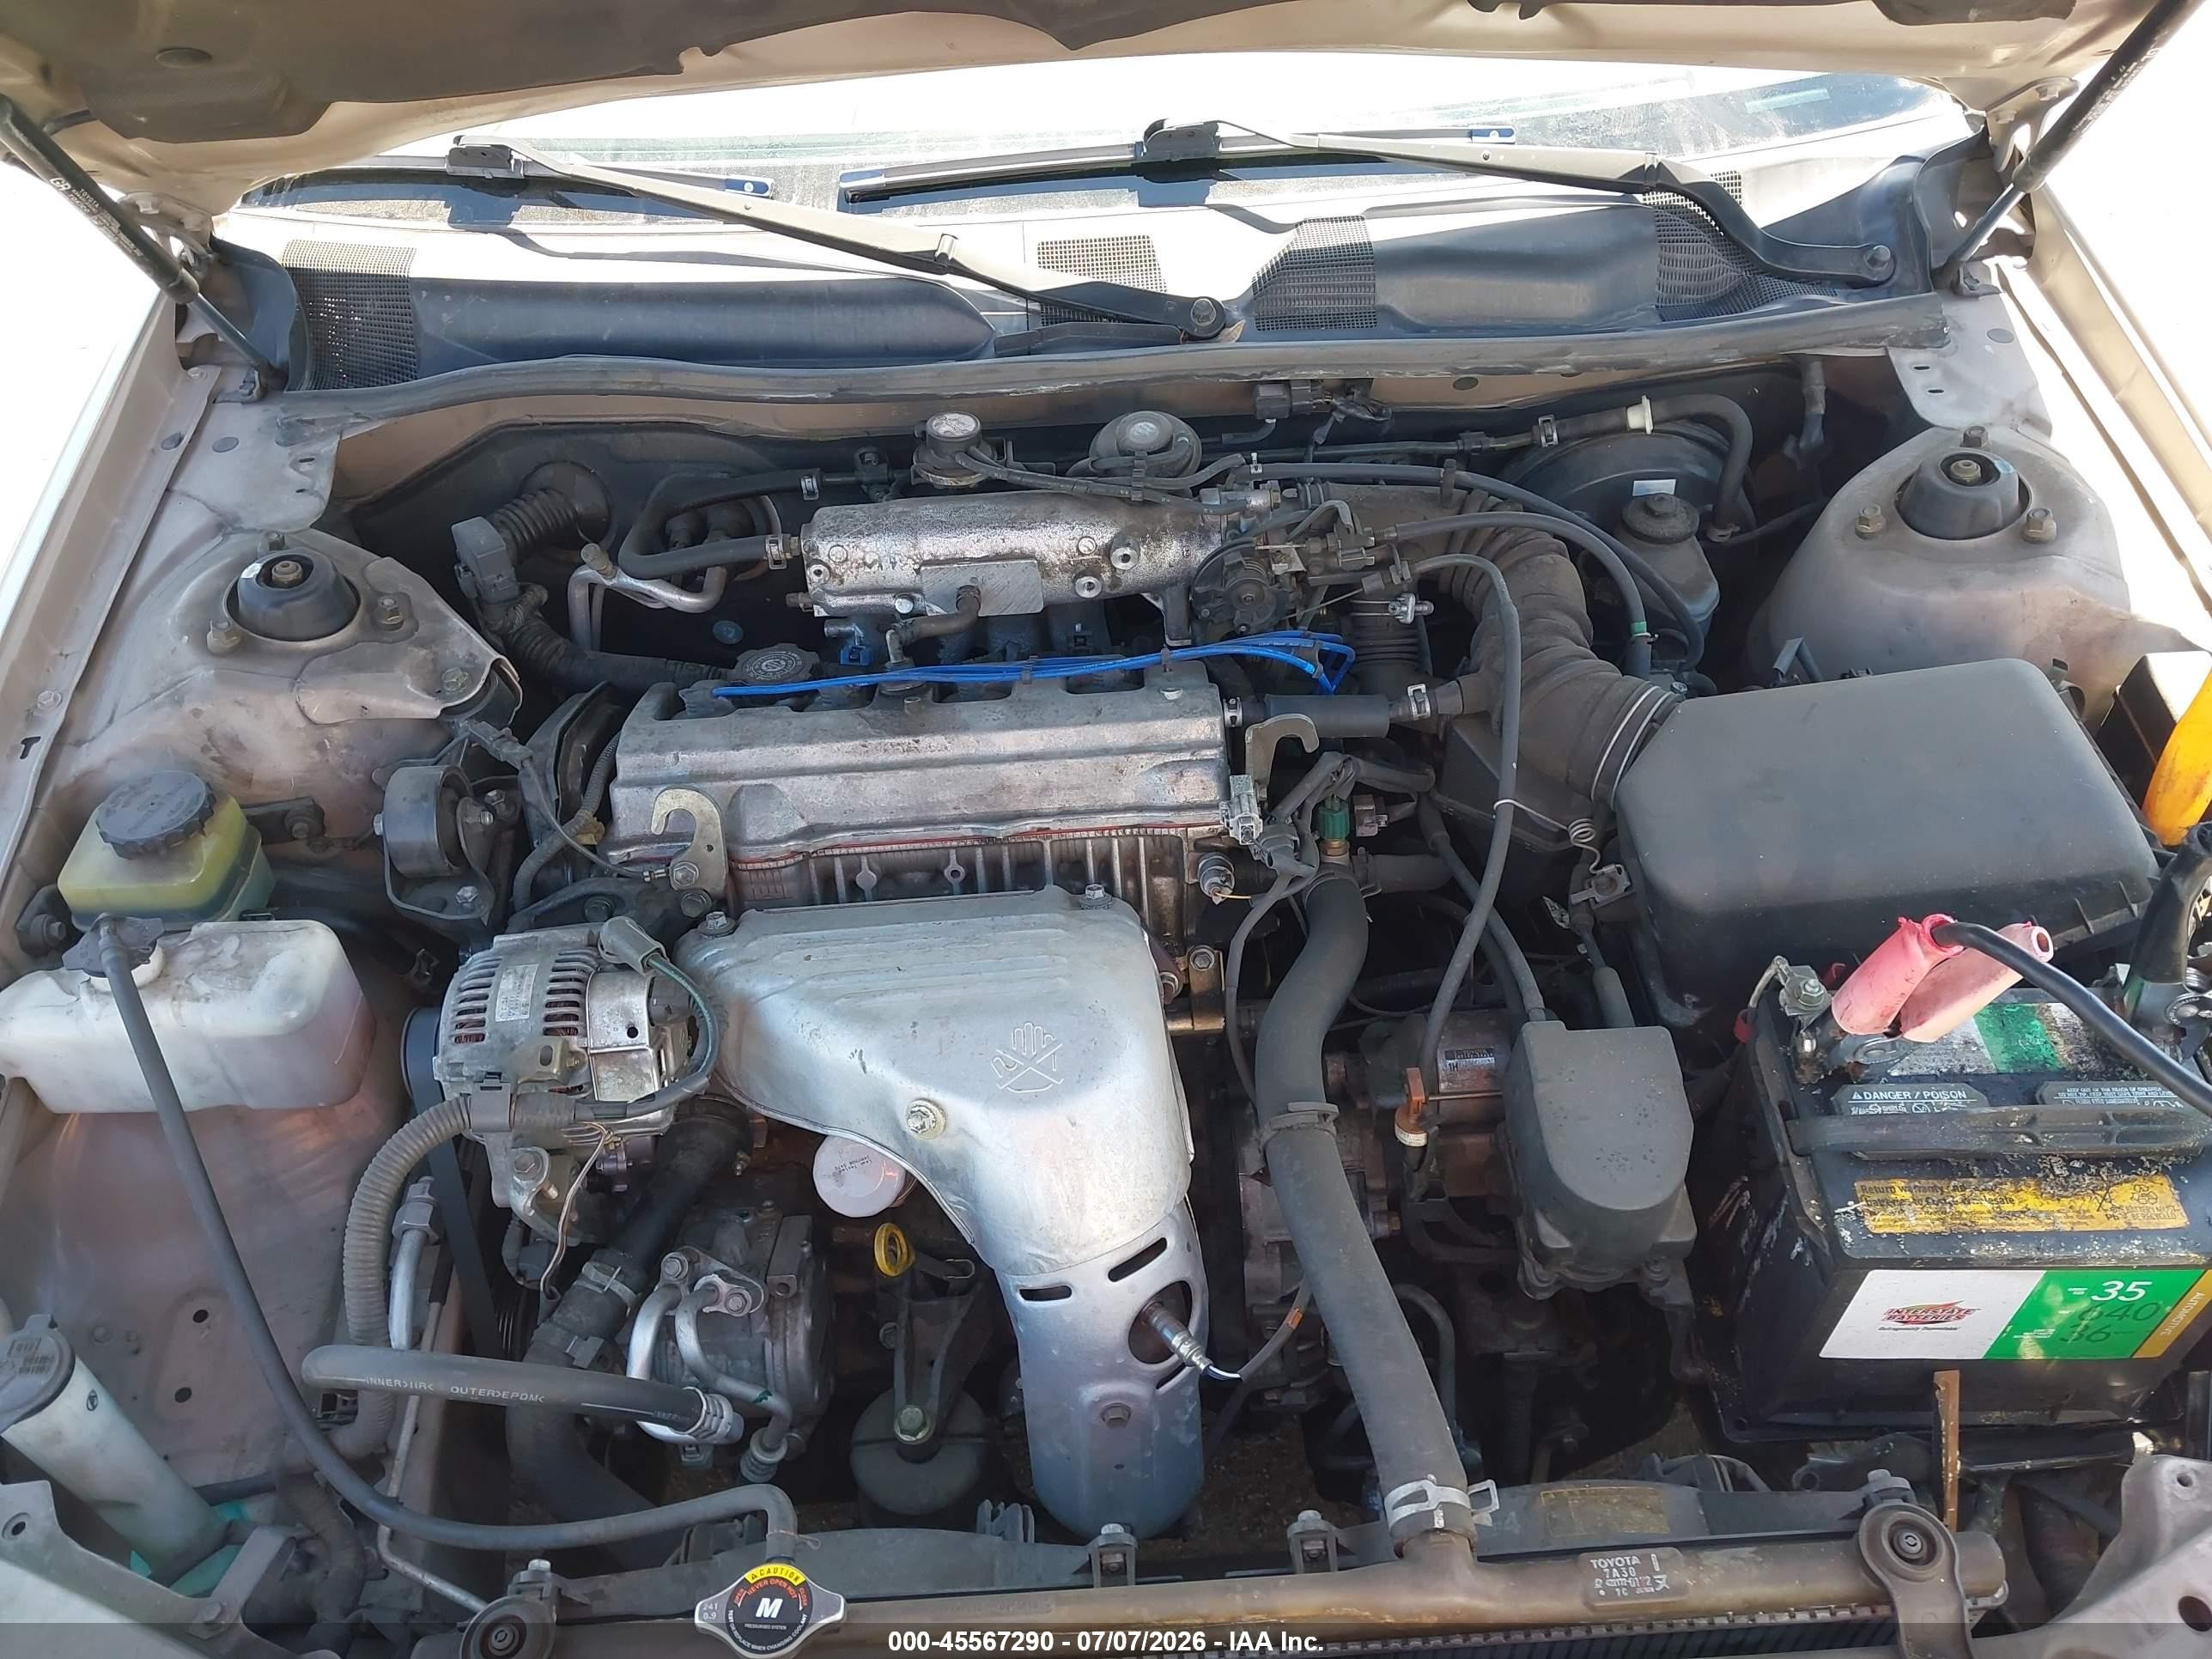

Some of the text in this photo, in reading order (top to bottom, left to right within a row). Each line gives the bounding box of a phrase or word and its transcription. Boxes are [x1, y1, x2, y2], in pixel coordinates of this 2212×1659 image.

[80, 188, 100, 208] TOYOTA
[1863, 1091, 1912, 1100] DANGER
[1923, 1091, 1967, 1099] POISON
[1861, 1184, 1898, 1194] Return
[2091, 1280, 2153, 1301] 35
[2078, 1302, 2160, 1322] 640
[2160, 1291, 2206, 1337] AUTOMOTIVE
[2061, 1324, 2112, 1343] 36
[1590, 1555, 1641, 1569] TOYOTA
[759, 1566, 799, 1583] CAUTION
[746, 1578, 798, 1600] NEVER OPEN HOT
[755, 1597, 783, 1618] M
[792, 1613, 808, 1638] COOLANT
